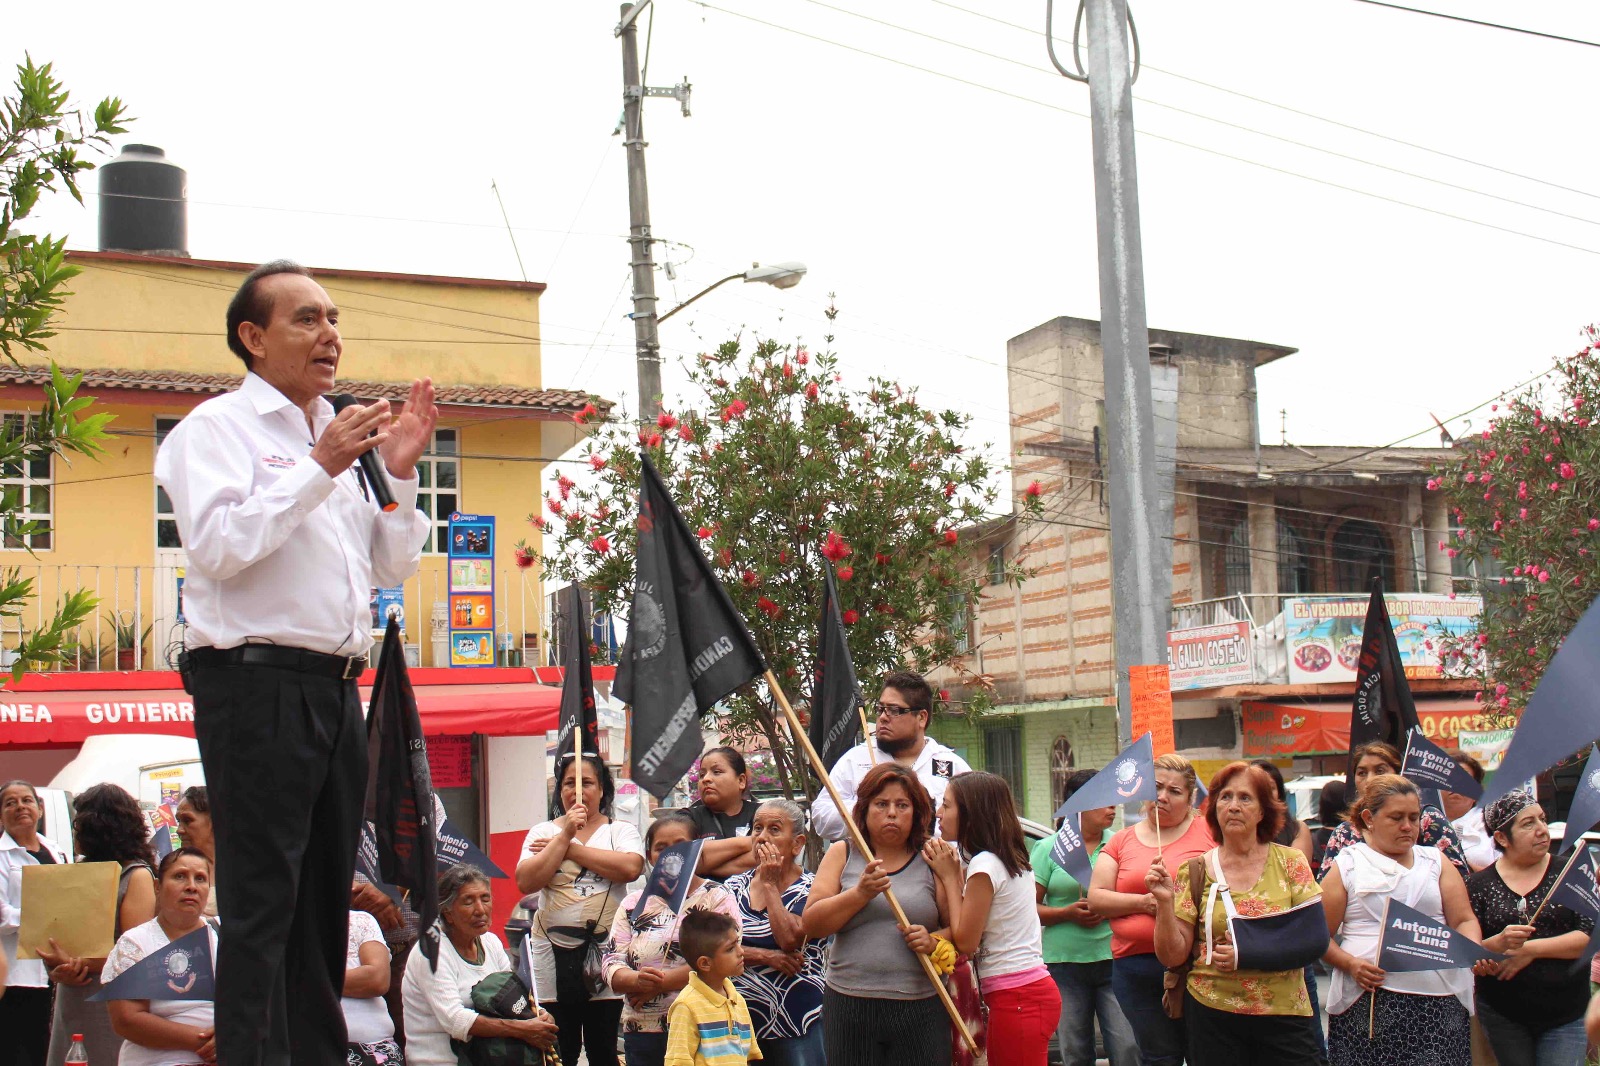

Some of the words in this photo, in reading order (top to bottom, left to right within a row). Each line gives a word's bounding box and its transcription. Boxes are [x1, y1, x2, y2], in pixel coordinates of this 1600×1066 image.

[1294, 604, 1309, 618] EL
[1178, 642, 1205, 670] GALLO
[1207, 634, 1247, 667] COSTEÑO
[1407, 747, 1456, 769] Antonio
[1421, 758, 1452, 776] Luna
[436, 832, 469, 850] Antonio
[442, 842, 465, 858] Luna
[1391, 918, 1451, 939] Antonio
[1413, 932, 1449, 949] Luna
